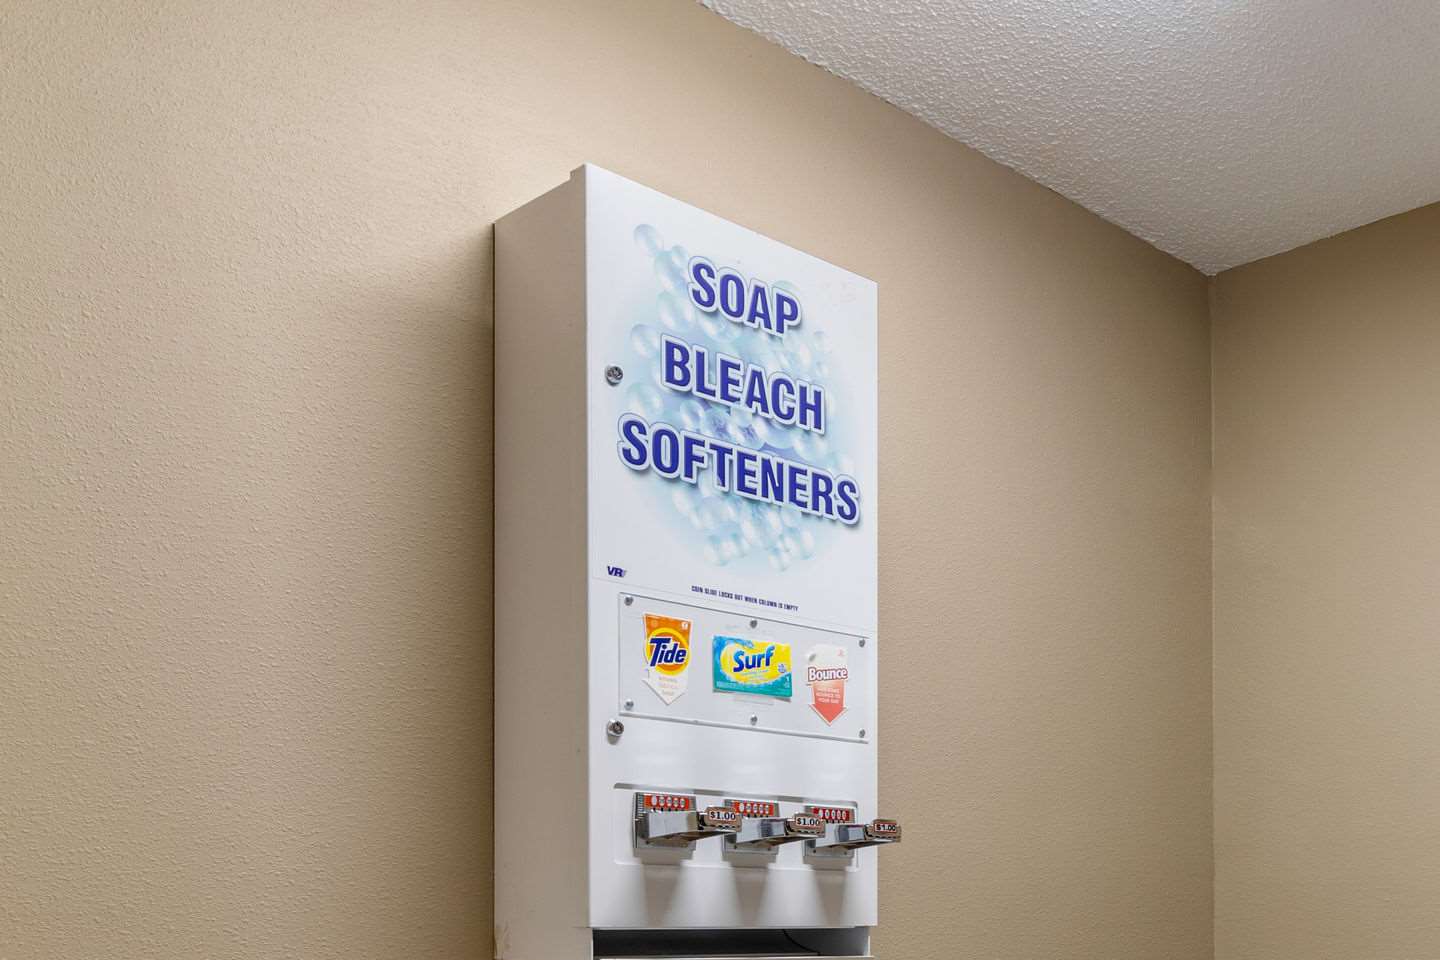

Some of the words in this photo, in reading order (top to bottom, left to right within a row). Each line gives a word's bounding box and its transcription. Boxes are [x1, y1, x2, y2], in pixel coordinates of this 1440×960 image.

[690, 261, 800, 335] SOAP
[663, 338, 823, 431] BLEACH
[620, 418, 859, 522] SOFTENERS
[691, 585, 703, 593] COIN
[719, 590, 733, 599] LOCKS
[784, 603, 799, 611] EMPTY
[650, 637, 687, 667] Tide
[733, 645, 775, 673] Surf
[808, 667, 848, 682] Bounce
[709, 809, 736, 821] $1.00
[796, 816, 820, 827] $1.00
[876, 823, 896, 832] $1.00
